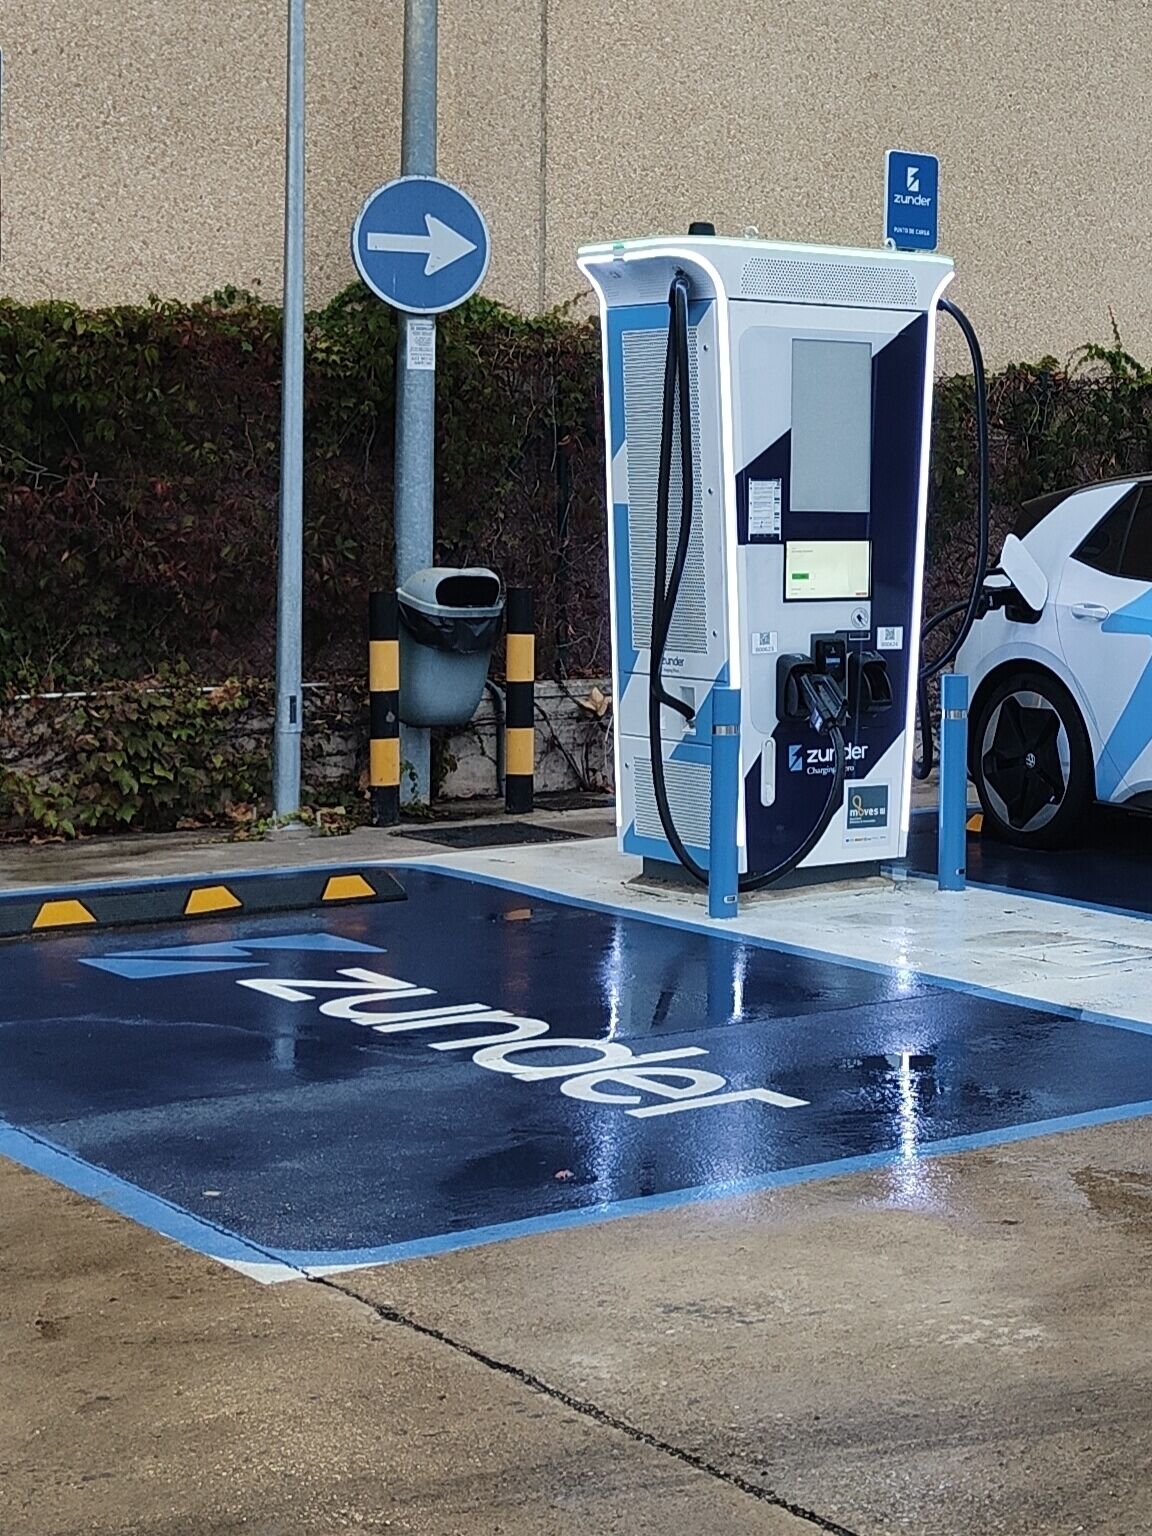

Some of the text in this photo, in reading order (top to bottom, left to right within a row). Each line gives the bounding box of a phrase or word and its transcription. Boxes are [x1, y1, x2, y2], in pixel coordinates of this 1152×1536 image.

[893, 193, 931, 207] zunder
[850, 808, 879, 817] moves
[236, 967, 811, 1119] zunder
